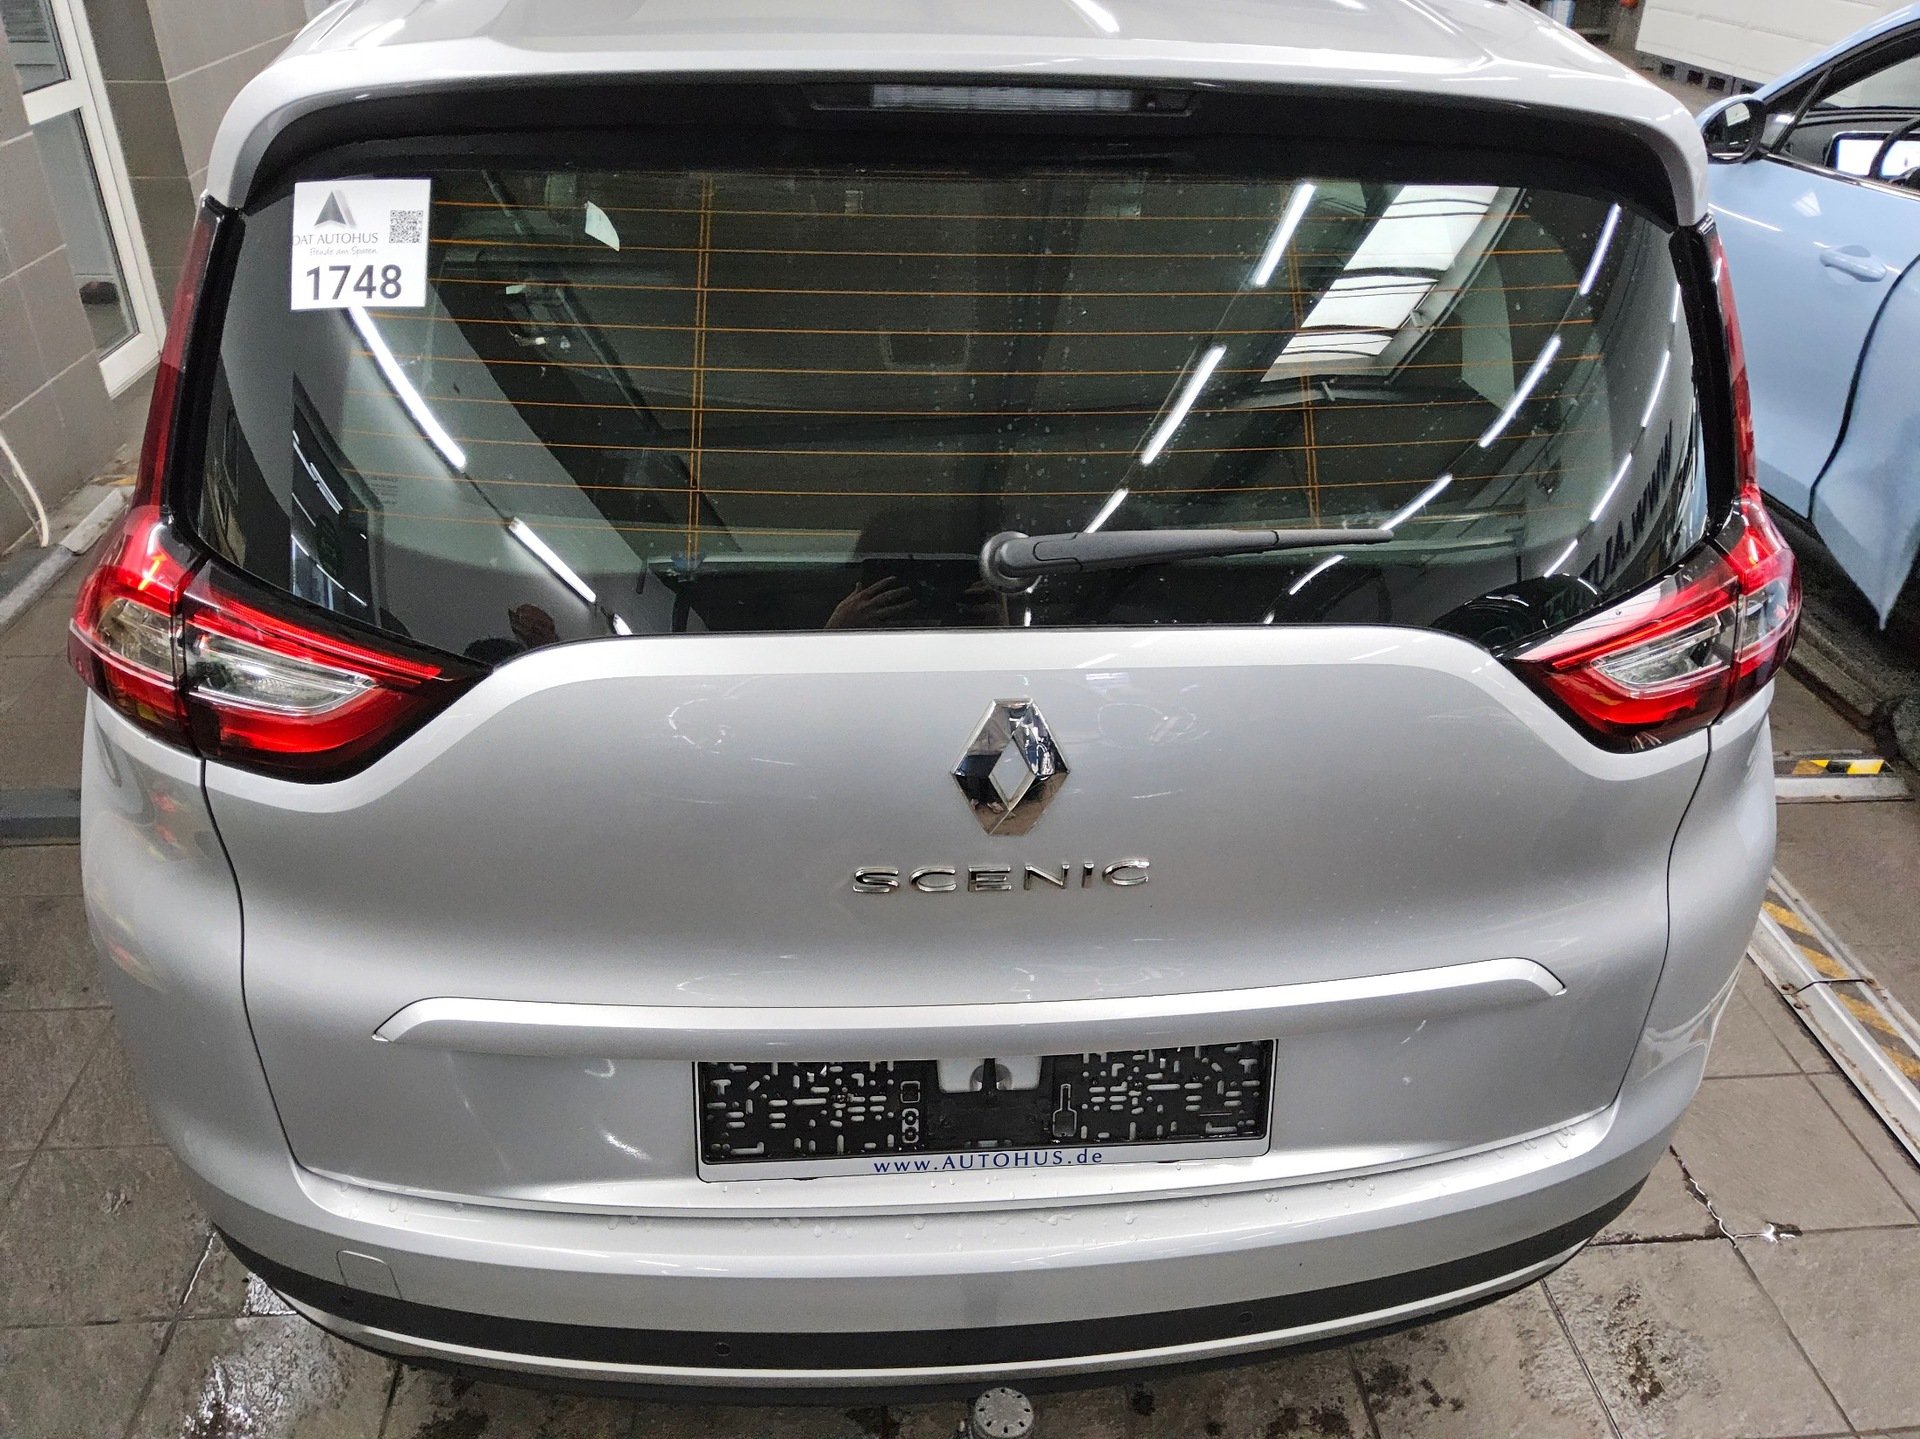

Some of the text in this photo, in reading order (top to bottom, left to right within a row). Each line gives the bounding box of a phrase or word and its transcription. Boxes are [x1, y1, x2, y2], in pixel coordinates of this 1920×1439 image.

[317, 233, 378, 245] AUTOHUS
[306, 264, 402, 301] 1748
[852, 858, 1150, 893] SCENIC
[873, 1149, 1103, 1175] www.AUTOHUS.de
